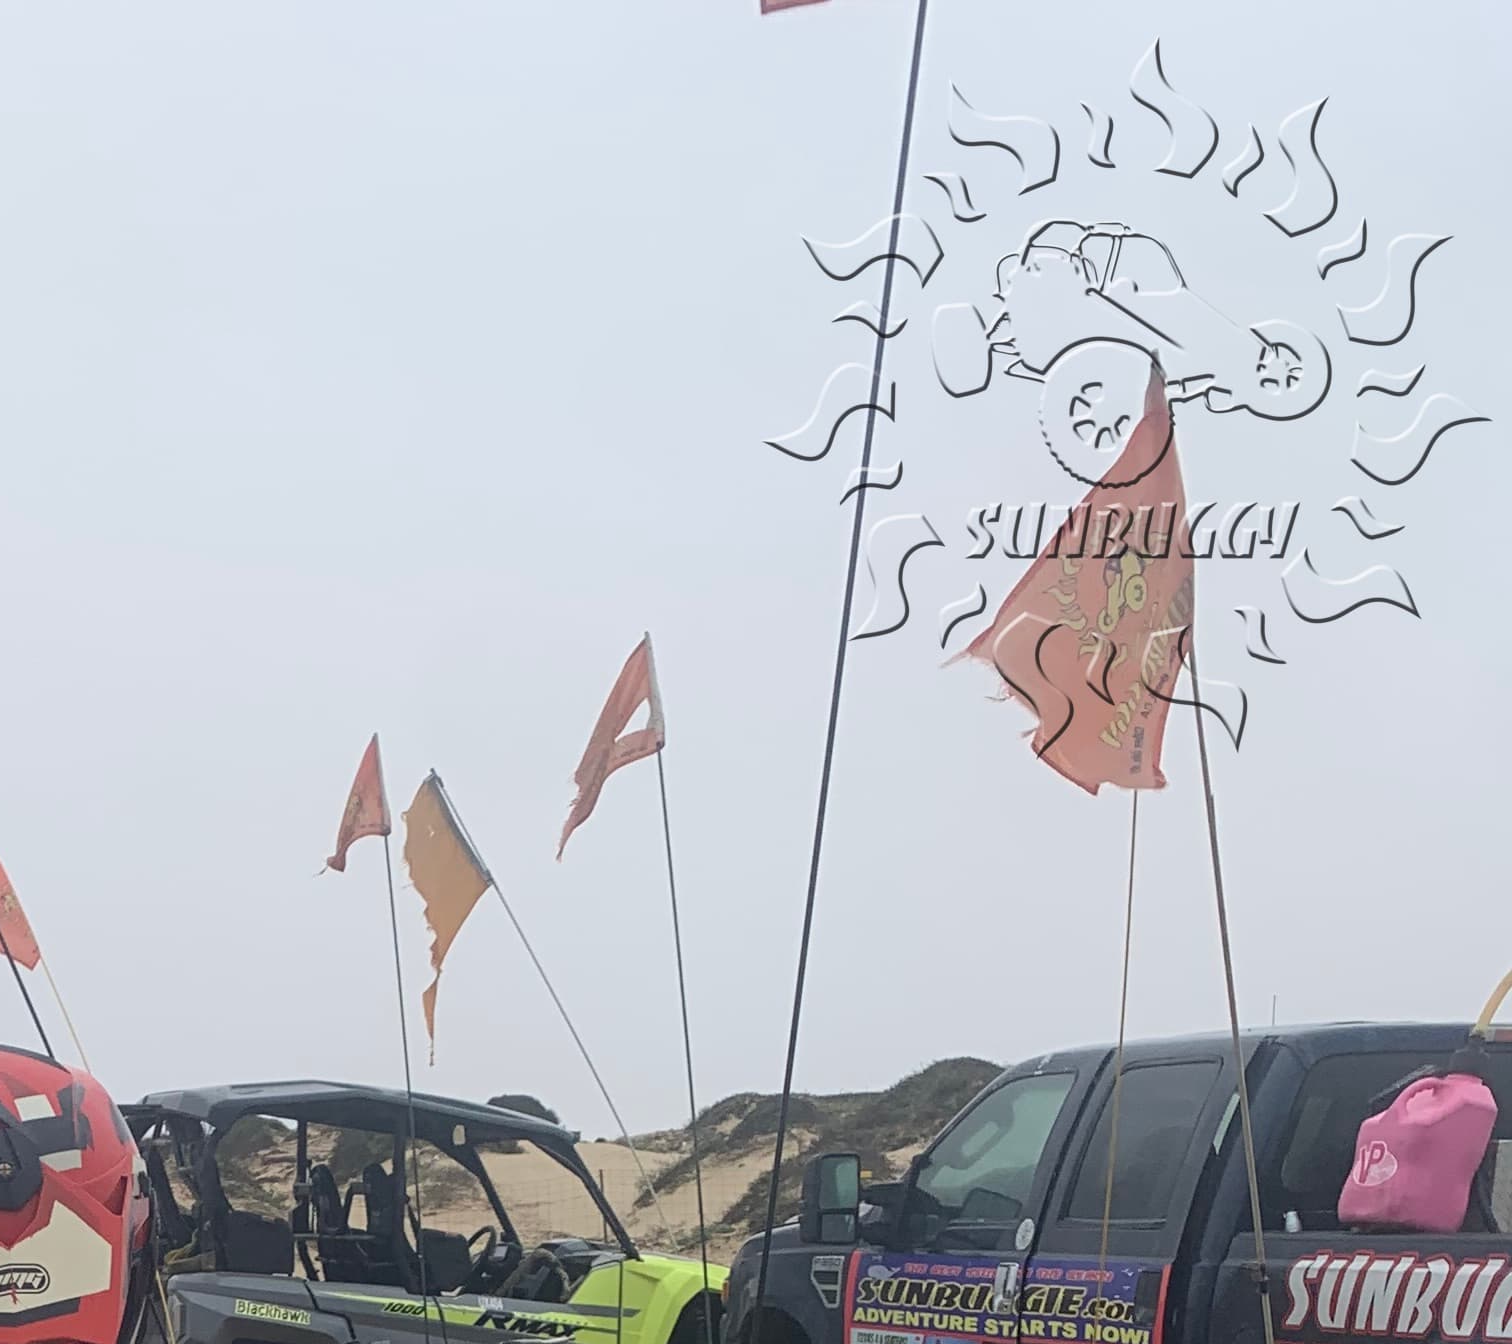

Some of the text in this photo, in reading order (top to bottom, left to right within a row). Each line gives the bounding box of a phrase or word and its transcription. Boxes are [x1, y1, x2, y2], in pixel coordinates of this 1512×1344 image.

[236, 1302, 310, 1323] Blackhawk
[384, 1302, 426, 1315] 1000
[854, 1307, 978, 1332] ADVENTURE
[984, 1318, 1077, 1338] STARTS
